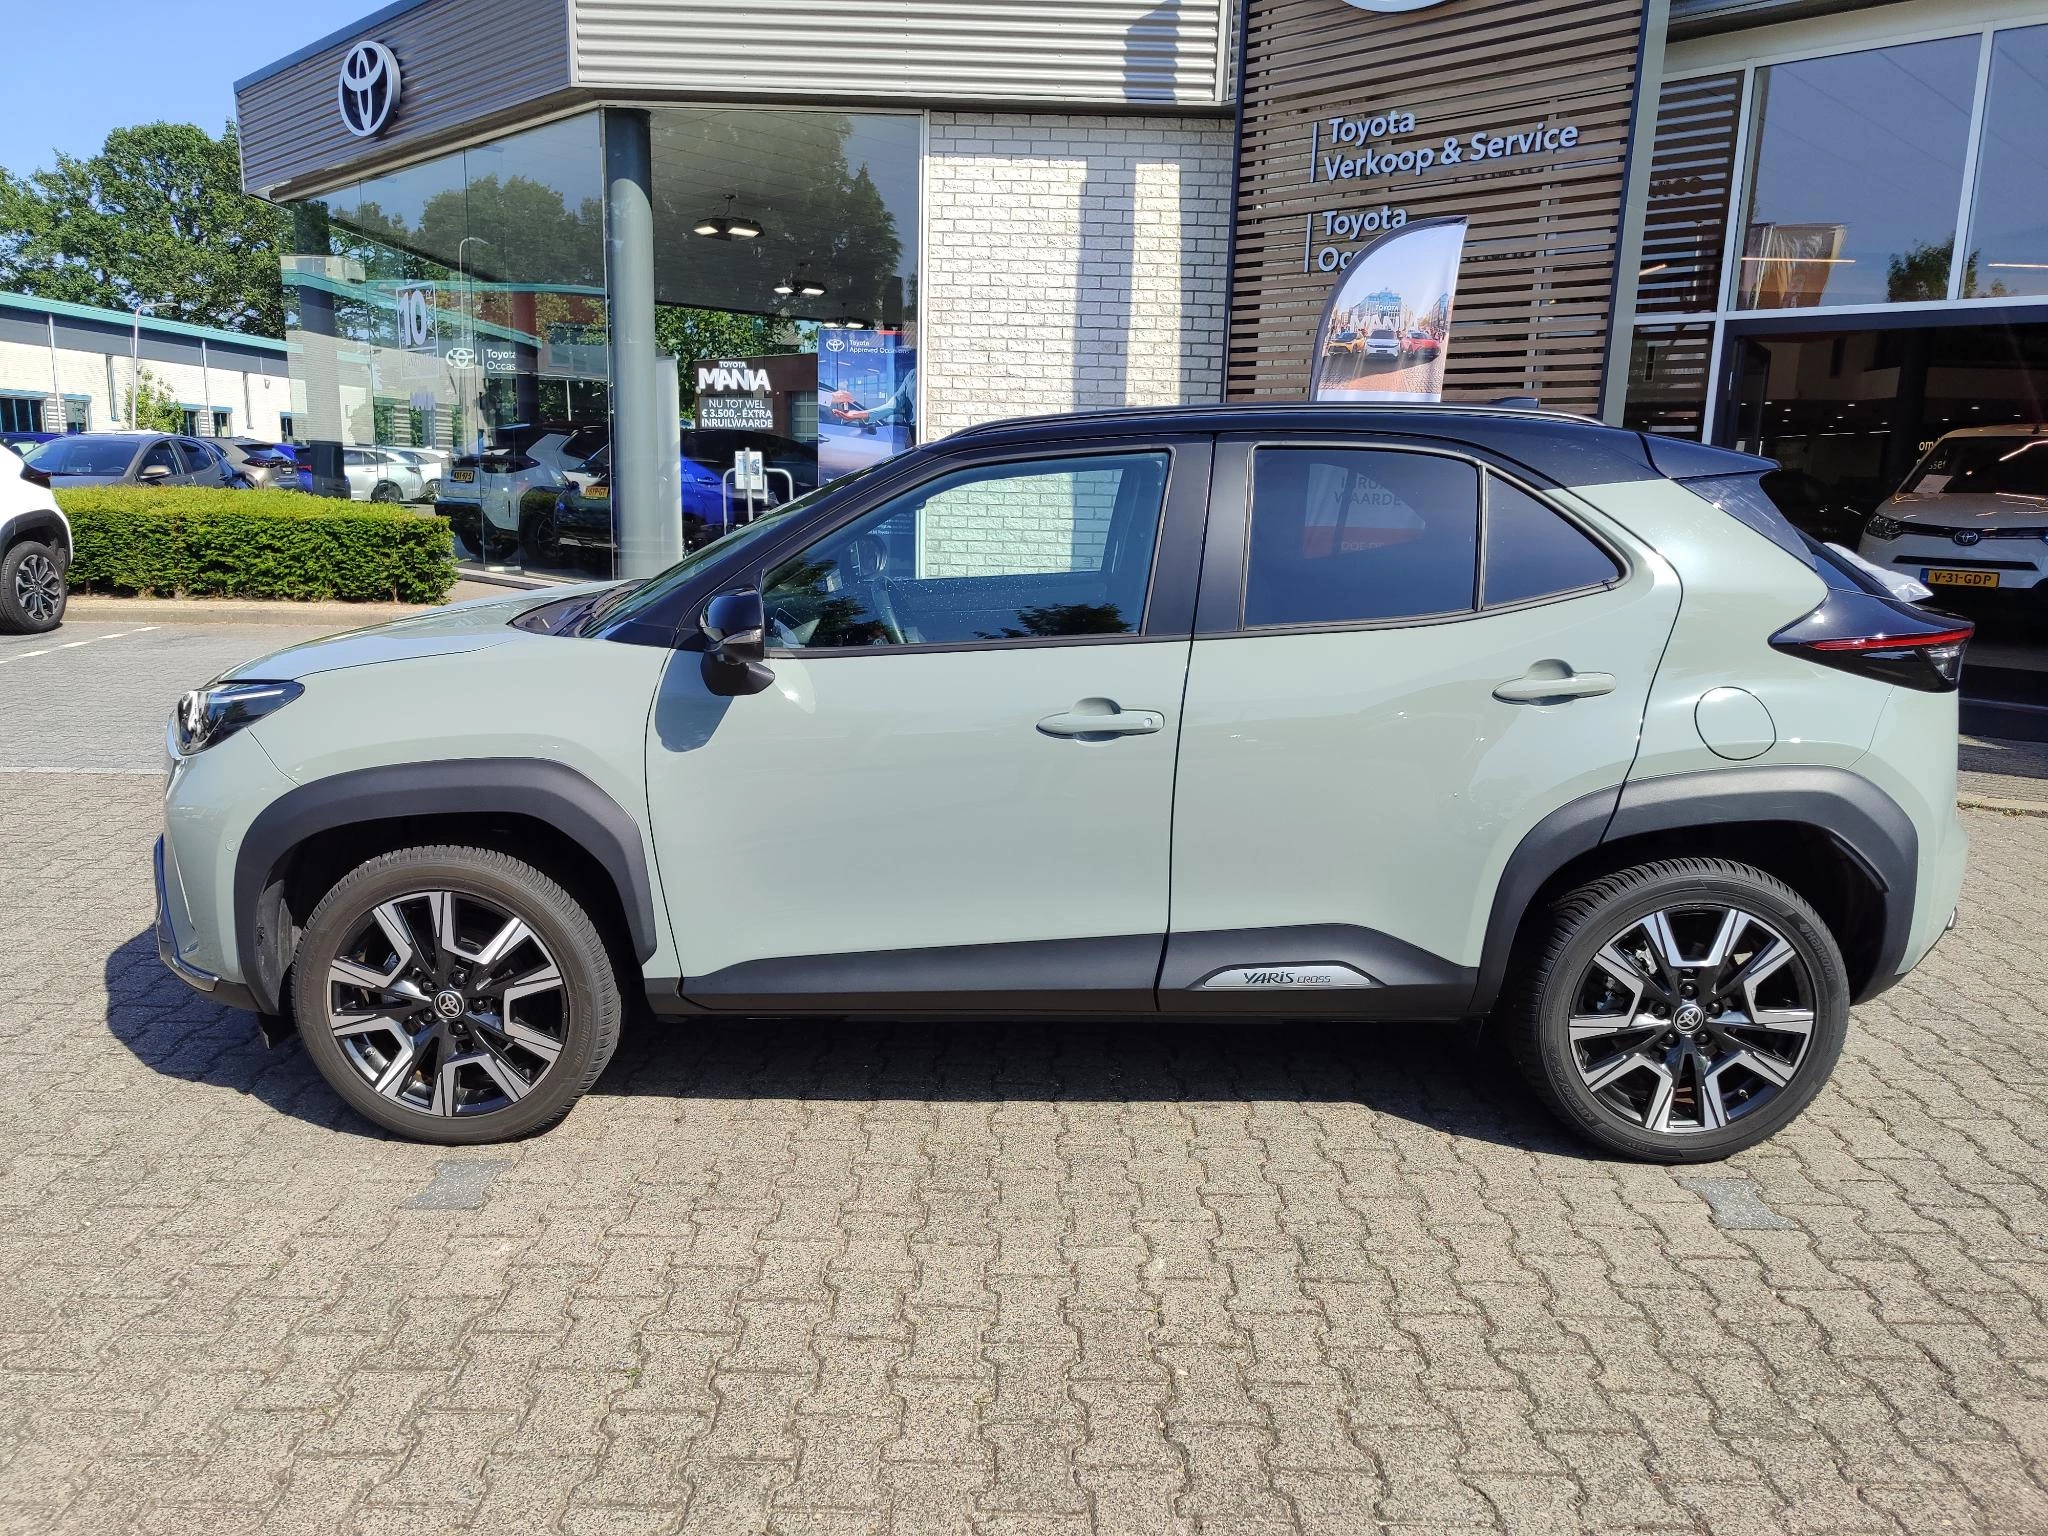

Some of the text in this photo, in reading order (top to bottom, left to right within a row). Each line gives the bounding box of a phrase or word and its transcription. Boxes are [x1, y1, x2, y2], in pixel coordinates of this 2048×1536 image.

[1328, 110, 1416, 146] Toyota
[1324, 122, 1580, 181] Verkoop & Service
[1322, 205, 1407, 240] Toyota
[400, 290, 427, 346] 10
[850, 339, 869, 347] Toyota
[487, 348, 516, 359] Toyota
[487, 361, 516, 370] Occas
[698, 368, 771, 391] MANIA
[709, 400, 765, 408] NU TOT WEL
[701, 419, 773, 428] INRUILWAARDE
[1934, 572, 1992, 586] V-31-GDP
[1297, 975, 1331, 984] CROSS
